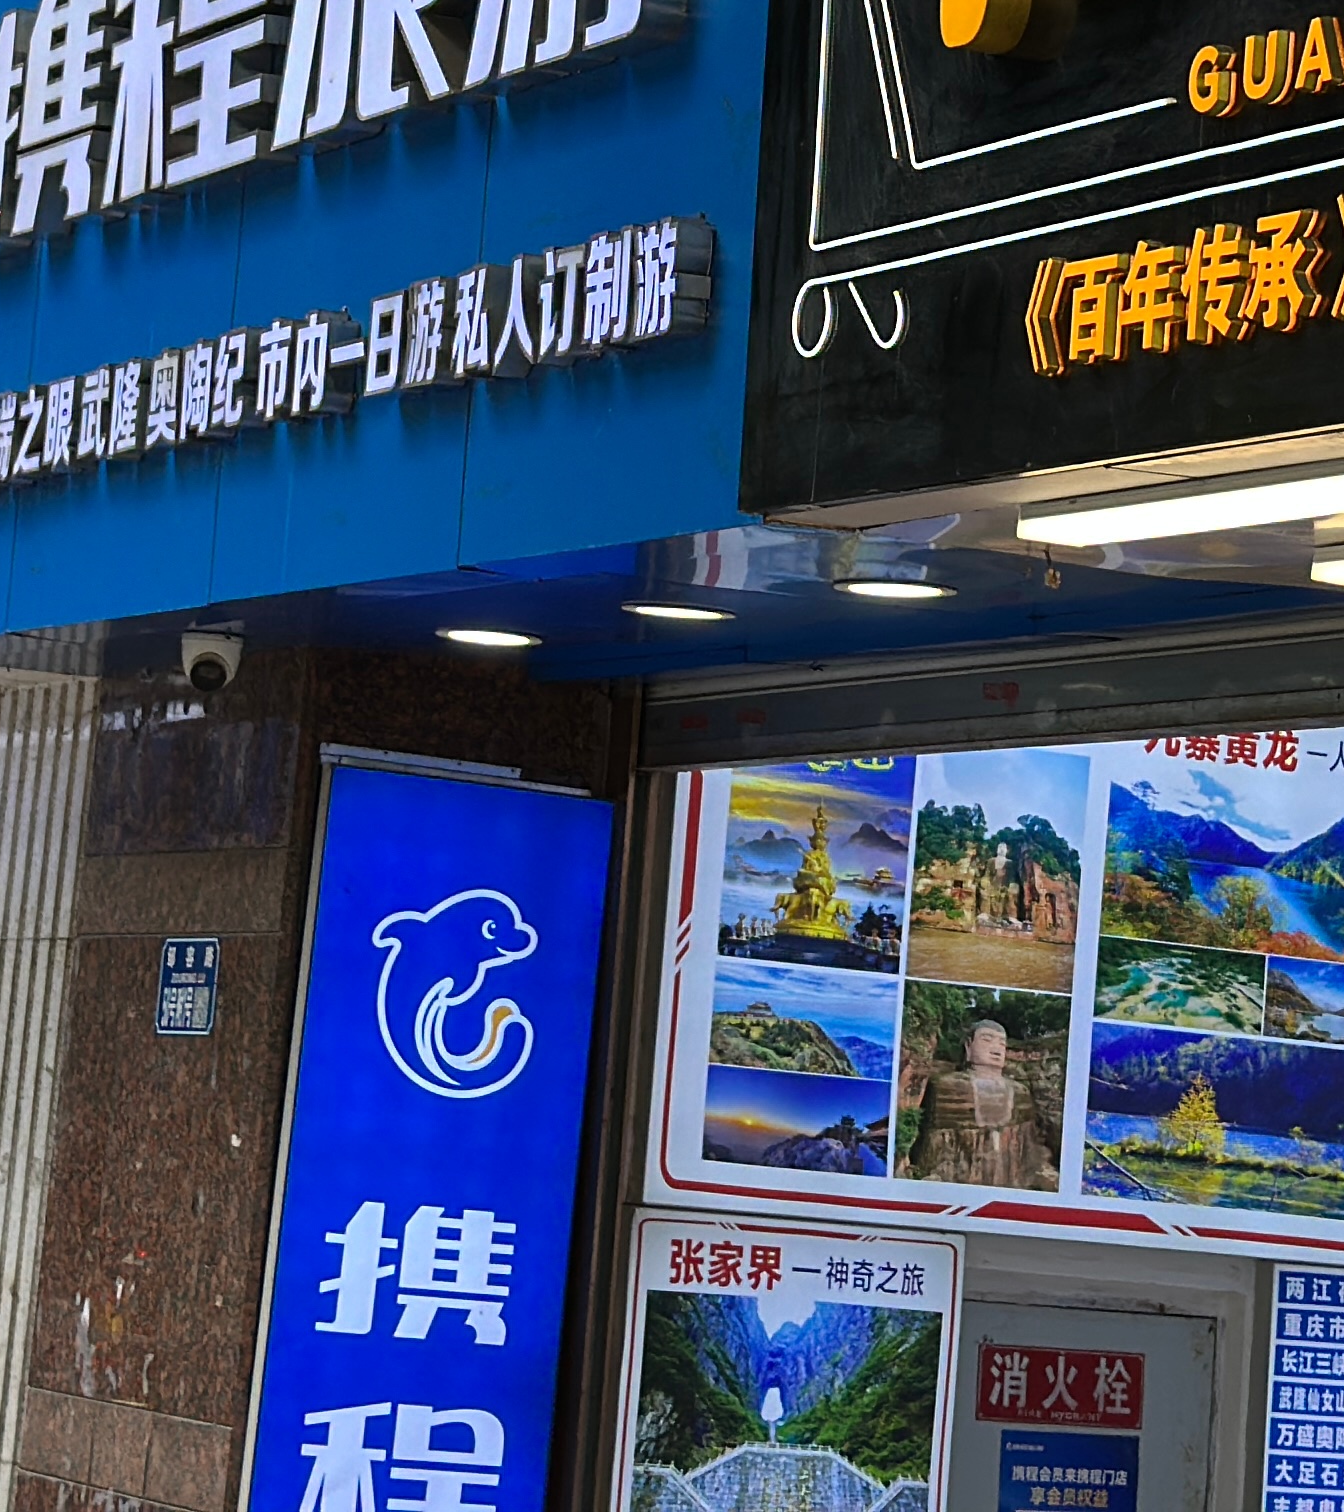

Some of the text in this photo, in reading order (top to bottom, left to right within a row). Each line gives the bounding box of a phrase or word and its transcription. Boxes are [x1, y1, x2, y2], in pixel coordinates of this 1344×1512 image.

[145, 335, 244, 449] 奥陶纪
[256, 280, 444, 420] 市内一日游
[455, 220, 679, 378] 私人订制游
[668, 1239, 783, 1291] 张家界
[298, 1201, 517, 1512] 携程
[988, 1350, 1133, 1415] 消火栓
